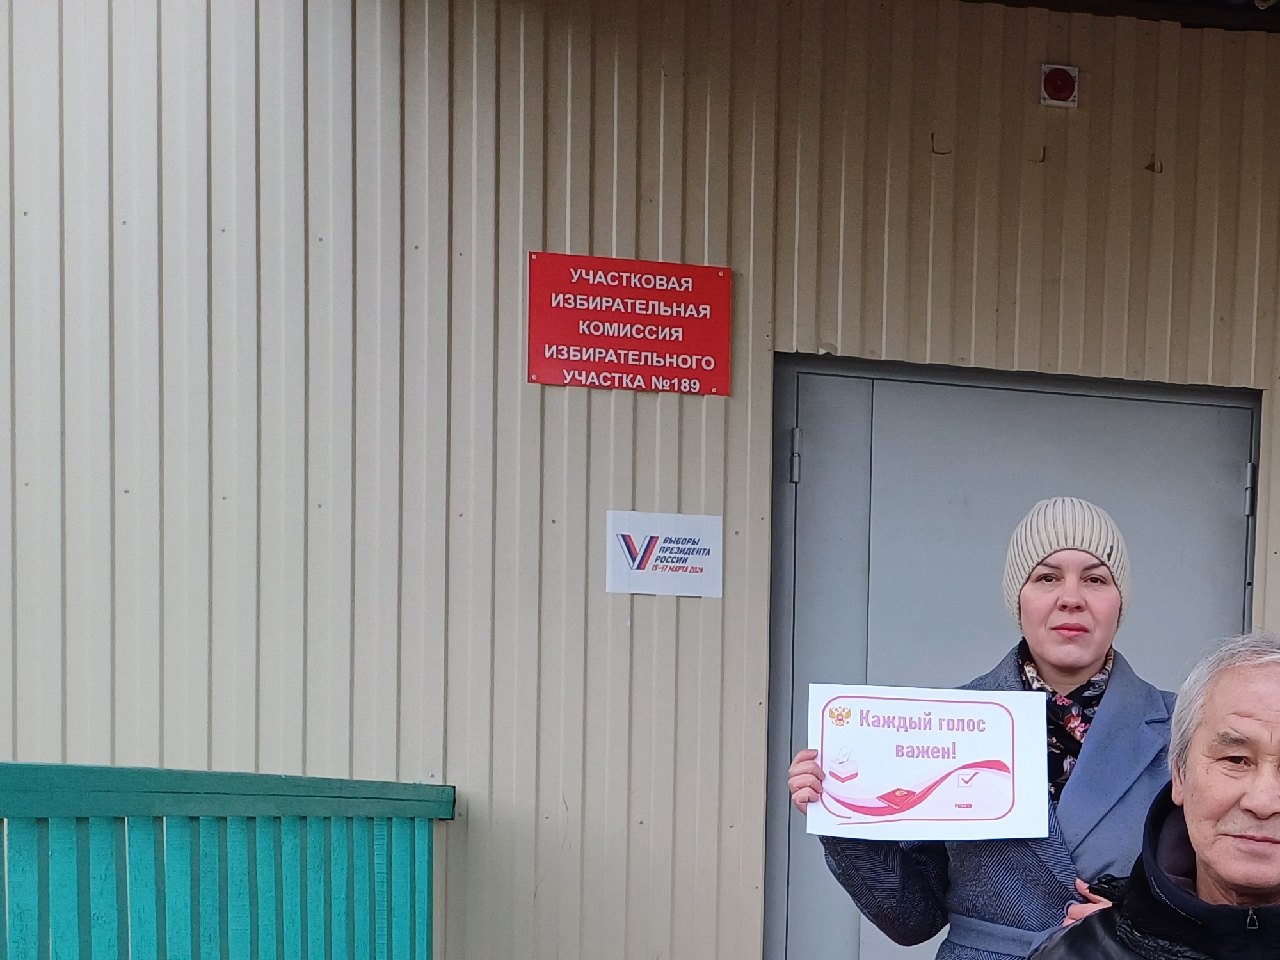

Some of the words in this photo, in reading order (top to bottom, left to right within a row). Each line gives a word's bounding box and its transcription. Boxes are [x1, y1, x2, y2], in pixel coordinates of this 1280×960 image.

[569, 267, 693, 292] УЧАСТКОВАЯ
[551, 293, 711, 319] ИЗБИРАТЕЛЬНАЯ
[579, 320, 683, 341] КОМИССИЯ
[544, 344, 715, 371] ИЗБИРАТЕЛЬНОГО
[563, 369, 646, 389] УЧАСТКА
[651, 375, 701, 393] №189
[659, 547, 711, 556] ПРЕЗИДЕНТА
[663, 537, 700, 546] ВЫБОРЫ
[654, 555, 689, 564] РОССИИ
[859, 709, 932, 733] Каждый
[938, 717, 986, 732] голос
[895, 742, 956, 760] важен!
